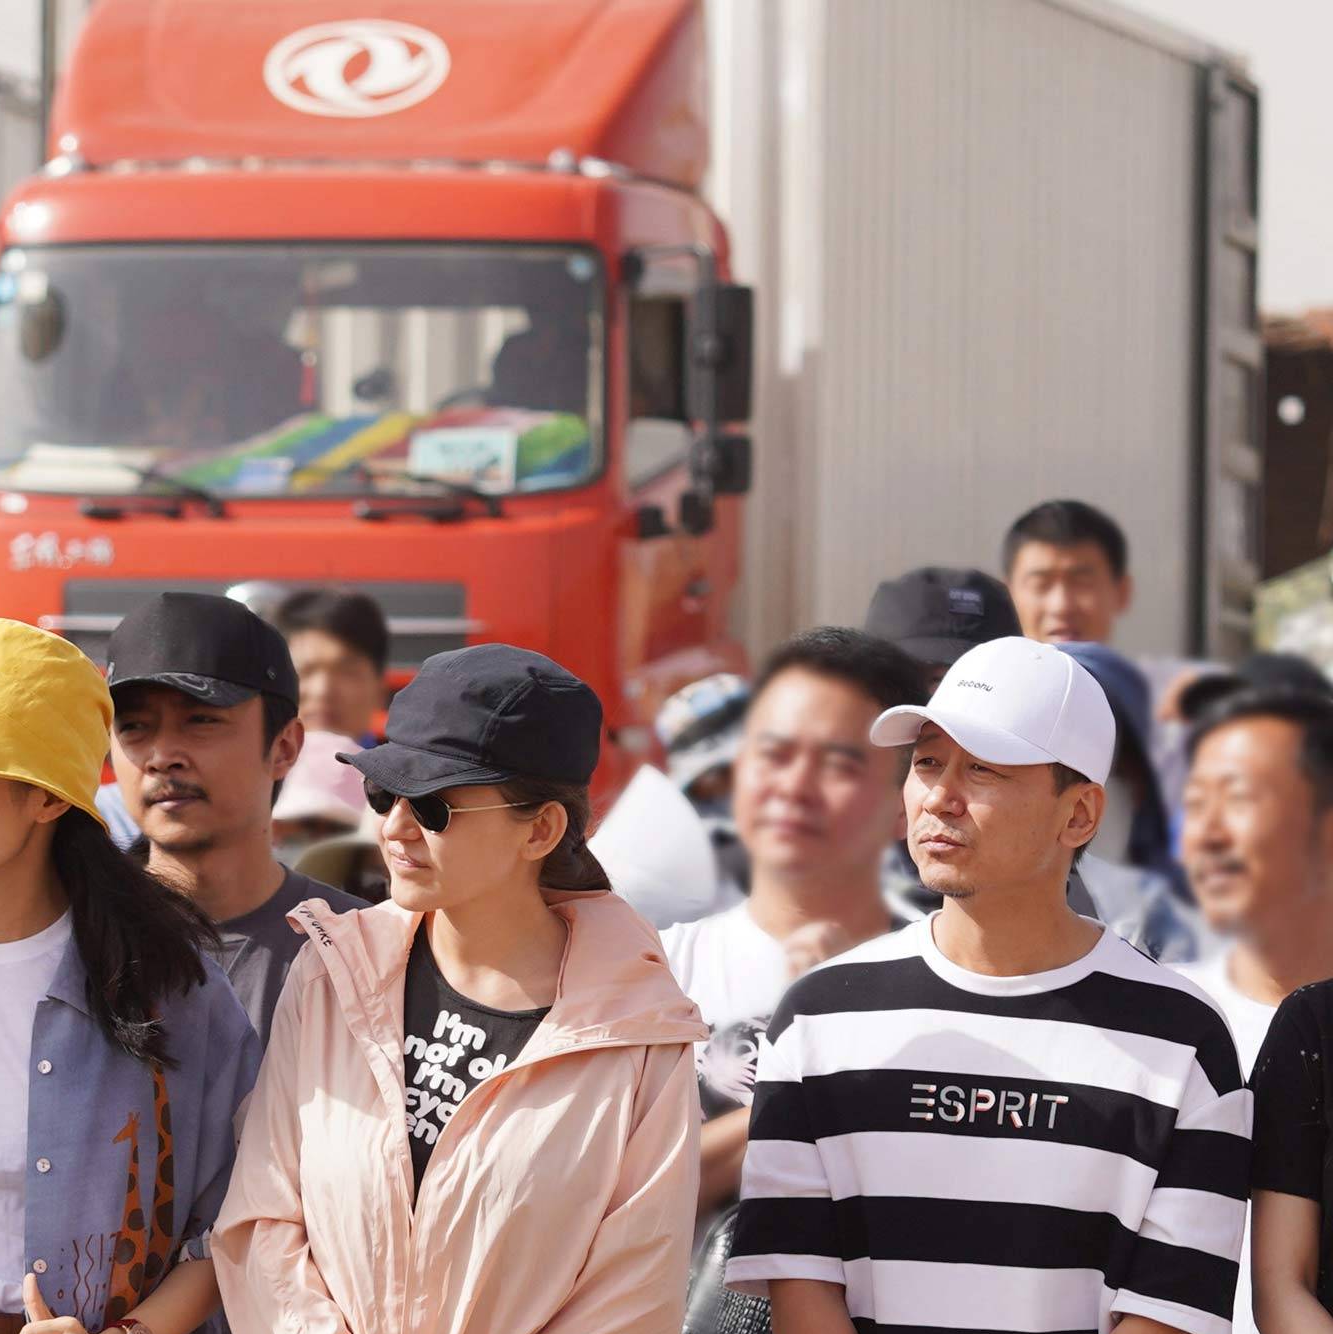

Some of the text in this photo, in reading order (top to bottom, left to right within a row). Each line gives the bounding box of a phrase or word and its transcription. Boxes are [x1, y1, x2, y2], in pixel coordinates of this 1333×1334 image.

[433, 1010, 486, 1050] I'm
[404, 1035, 507, 1080] not ol
[413, 1062, 467, 1101] I'm
[910, 1083, 1069, 1129] ESPRIT
